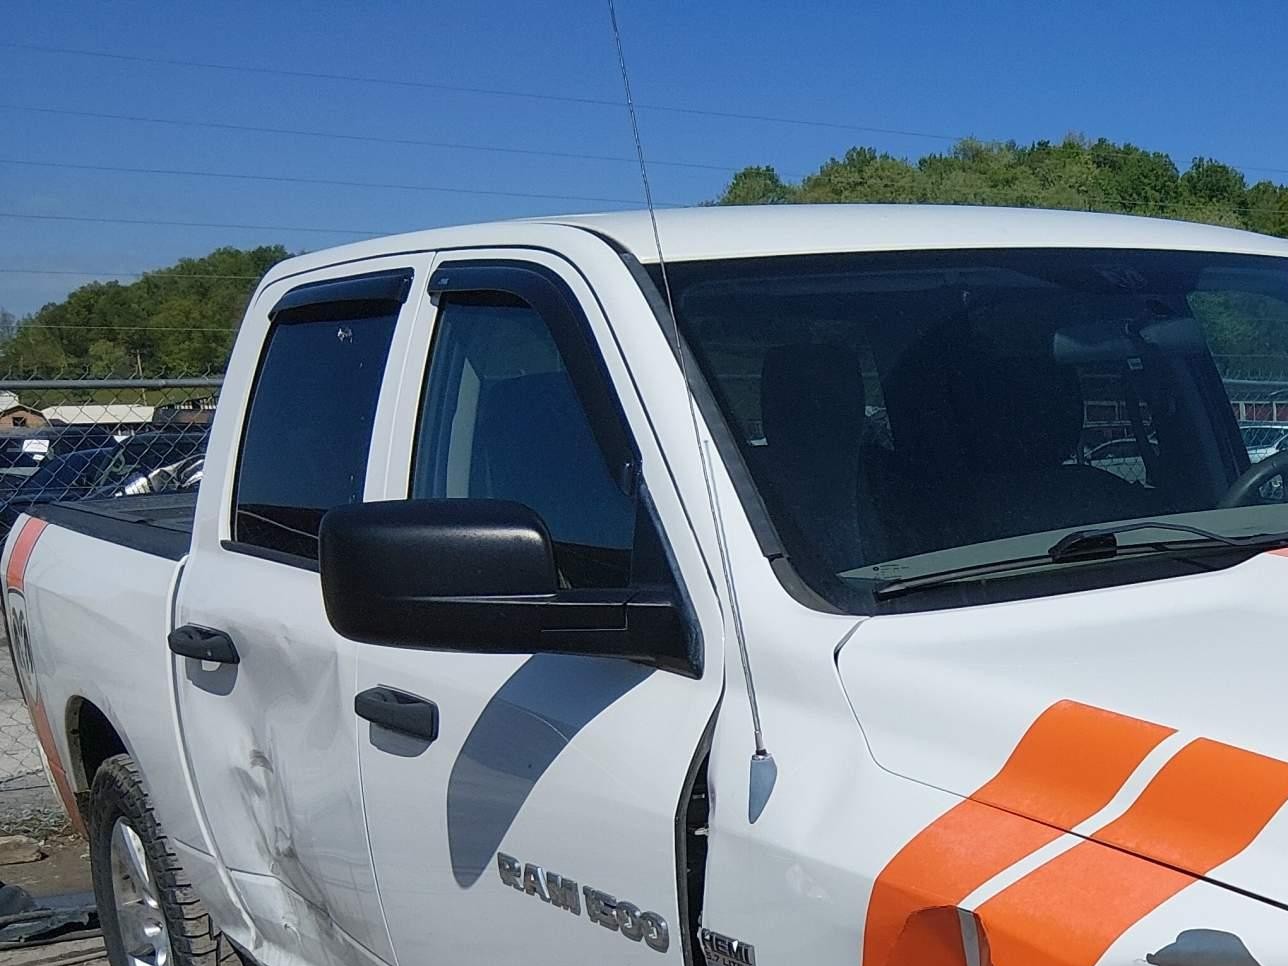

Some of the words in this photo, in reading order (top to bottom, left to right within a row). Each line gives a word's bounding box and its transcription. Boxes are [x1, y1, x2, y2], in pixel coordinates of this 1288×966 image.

[497, 852, 581, 916] RAM
[582, 885, 669, 953] 1500
[702, 928, 752, 965] HEMI
